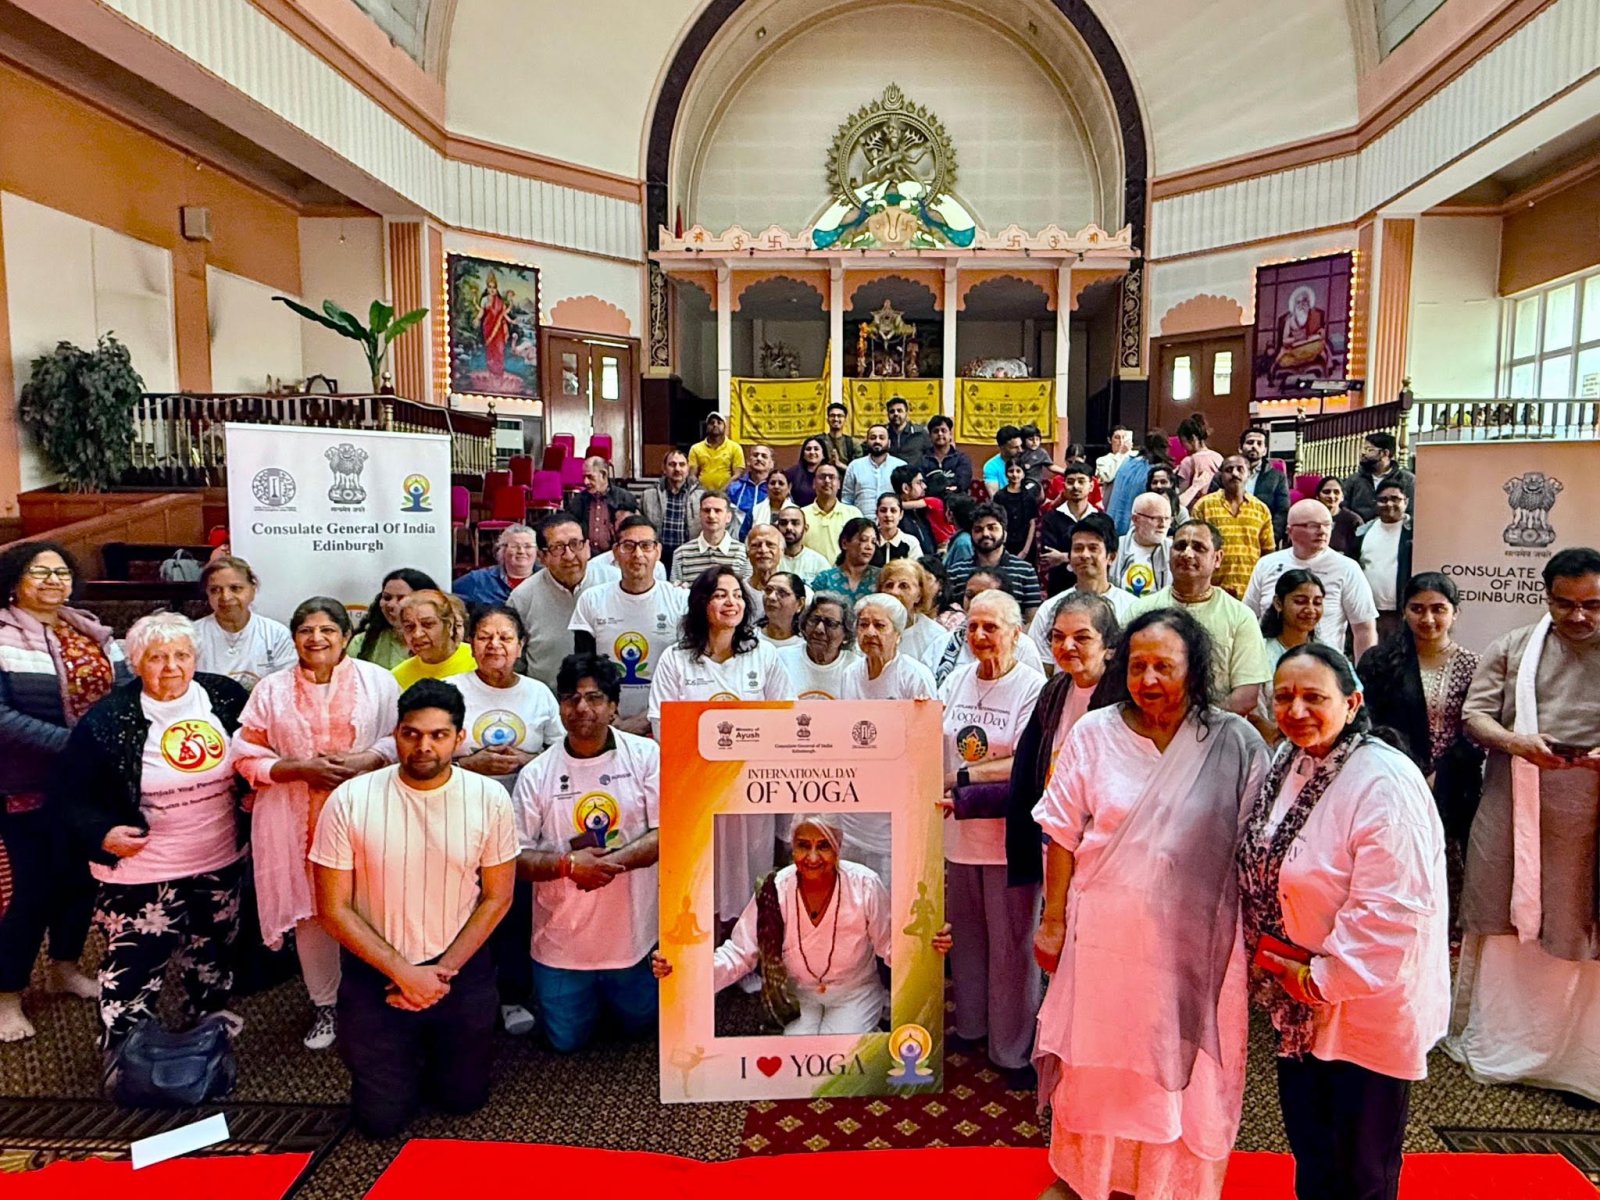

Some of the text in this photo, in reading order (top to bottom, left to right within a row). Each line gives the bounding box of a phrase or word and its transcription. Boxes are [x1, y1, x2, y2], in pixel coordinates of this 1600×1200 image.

[251, 522, 436, 535] Consulate General Of India
[312, 539, 384, 553] Edinburgh
[1441, 564, 1536, 579] CONSULATE
[1490, 578, 1546, 592] OF IND
[983, 711, 1009, 730] Day
[735, 732, 760, 740] Ayush
[748, 767, 858, 779] INTERNATIONAL DAY
[746, 780, 860, 803] OF YOGA
[741, 1053, 866, 1079] I YOGA
